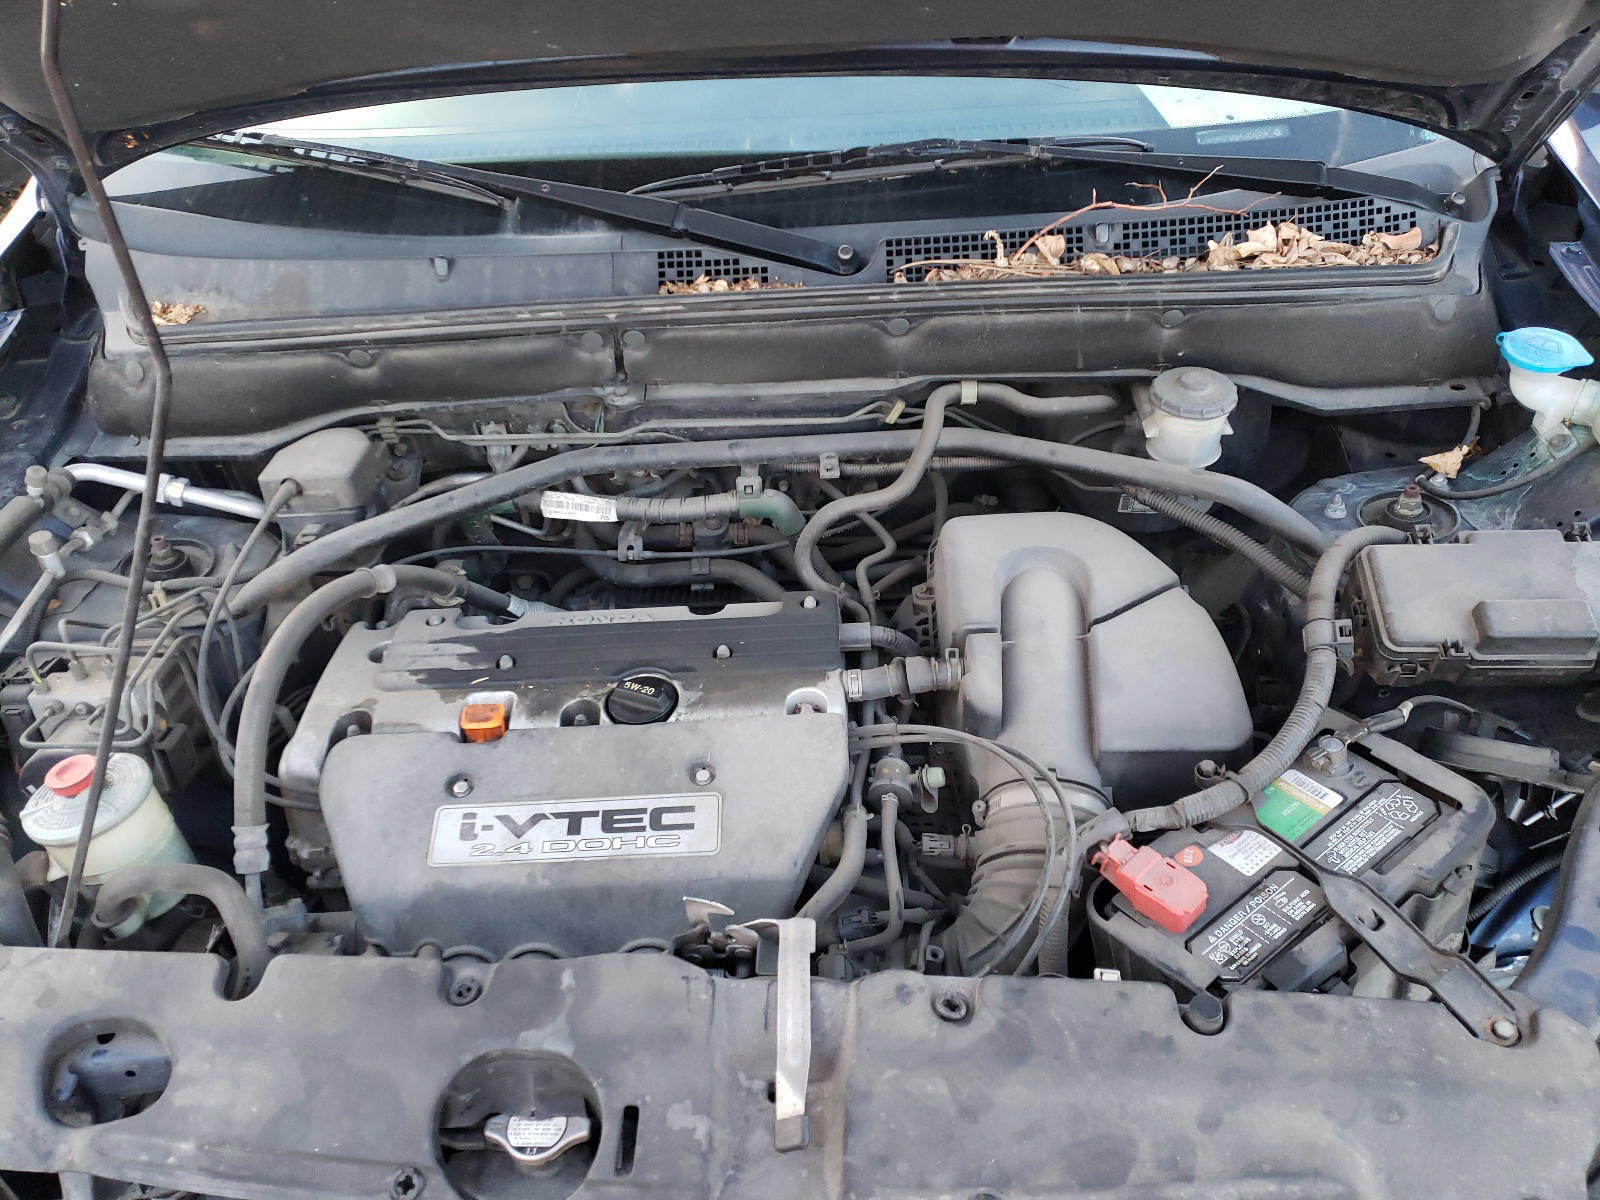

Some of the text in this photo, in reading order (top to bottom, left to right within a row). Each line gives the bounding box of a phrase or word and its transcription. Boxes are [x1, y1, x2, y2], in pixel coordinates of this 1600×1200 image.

[623, 681, 656, 695] 5W-20
[458, 806, 696, 842] i-VTEC
[470, 834, 681, 857] 2.4 DOHC
[1215, 909, 1247, 937] DANGER
[1250, 883, 1279, 908] POISON
